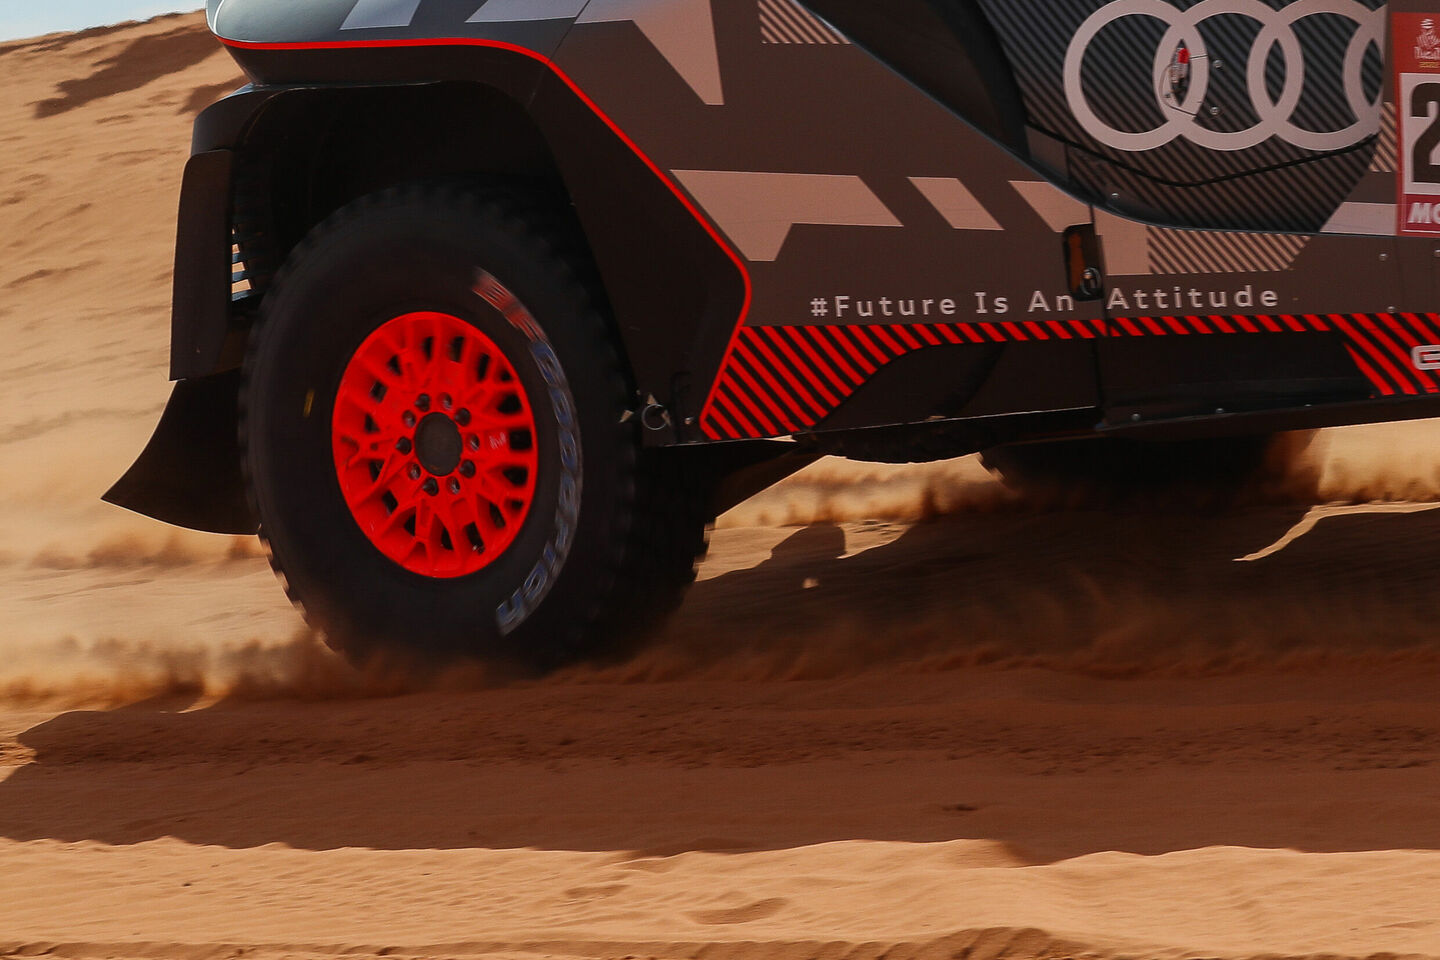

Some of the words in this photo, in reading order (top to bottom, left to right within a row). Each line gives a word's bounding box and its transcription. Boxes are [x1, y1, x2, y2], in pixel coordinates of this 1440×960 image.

[810, 294, 957, 317] #Future
[974, 291, 1009, 315] Is
[1027, 290, 1075, 313] An
[1106, 285, 1279, 310] Attitude
